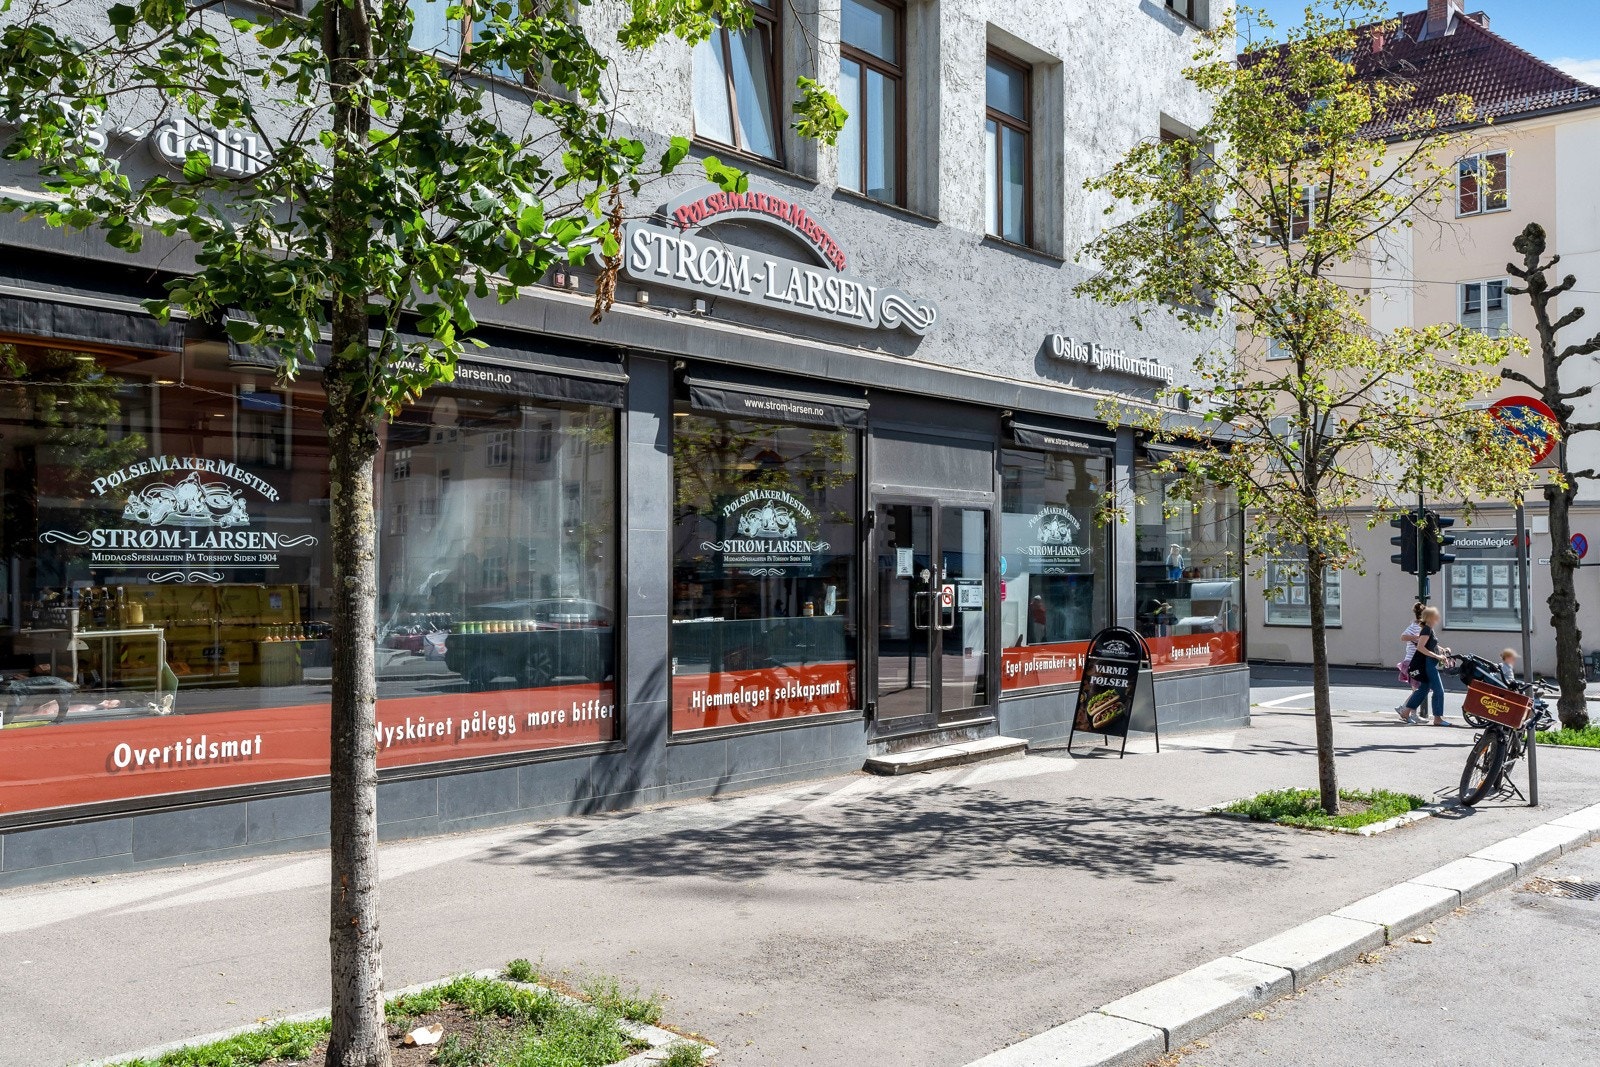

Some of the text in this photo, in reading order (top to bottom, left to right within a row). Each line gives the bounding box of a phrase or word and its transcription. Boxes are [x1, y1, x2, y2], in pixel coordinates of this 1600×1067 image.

[632, 228, 878, 322] STRØM-LARSEN
[1052, 334, 1174, 386] Oslos kjøttforretning
[744, 399, 824, 416] www.strom-larsen.no
[91, 529, 278, 550] STRØM-LARSEN
[723, 539, 811, 553] STRØM-LARSEN
[233, 553, 257, 563] SIDEN
[258, 553, 278, 563] 1904
[1005, 659, 1022, 677] Eget
[1068, 657, 1077, 671] og
[1095, 664, 1129, 676] VARME
[1090, 675, 1129, 688] PØLSER
[692, 680, 841, 712] Hjemmelaget selskapsmat
[1480, 695, 1510, 713] Carlsberg
[460, 710, 517, 740] pålegg
[527, 708, 566, 727] møre
[572, 699, 615, 722] biffer
[113, 734, 262, 768] Overtidsmat
